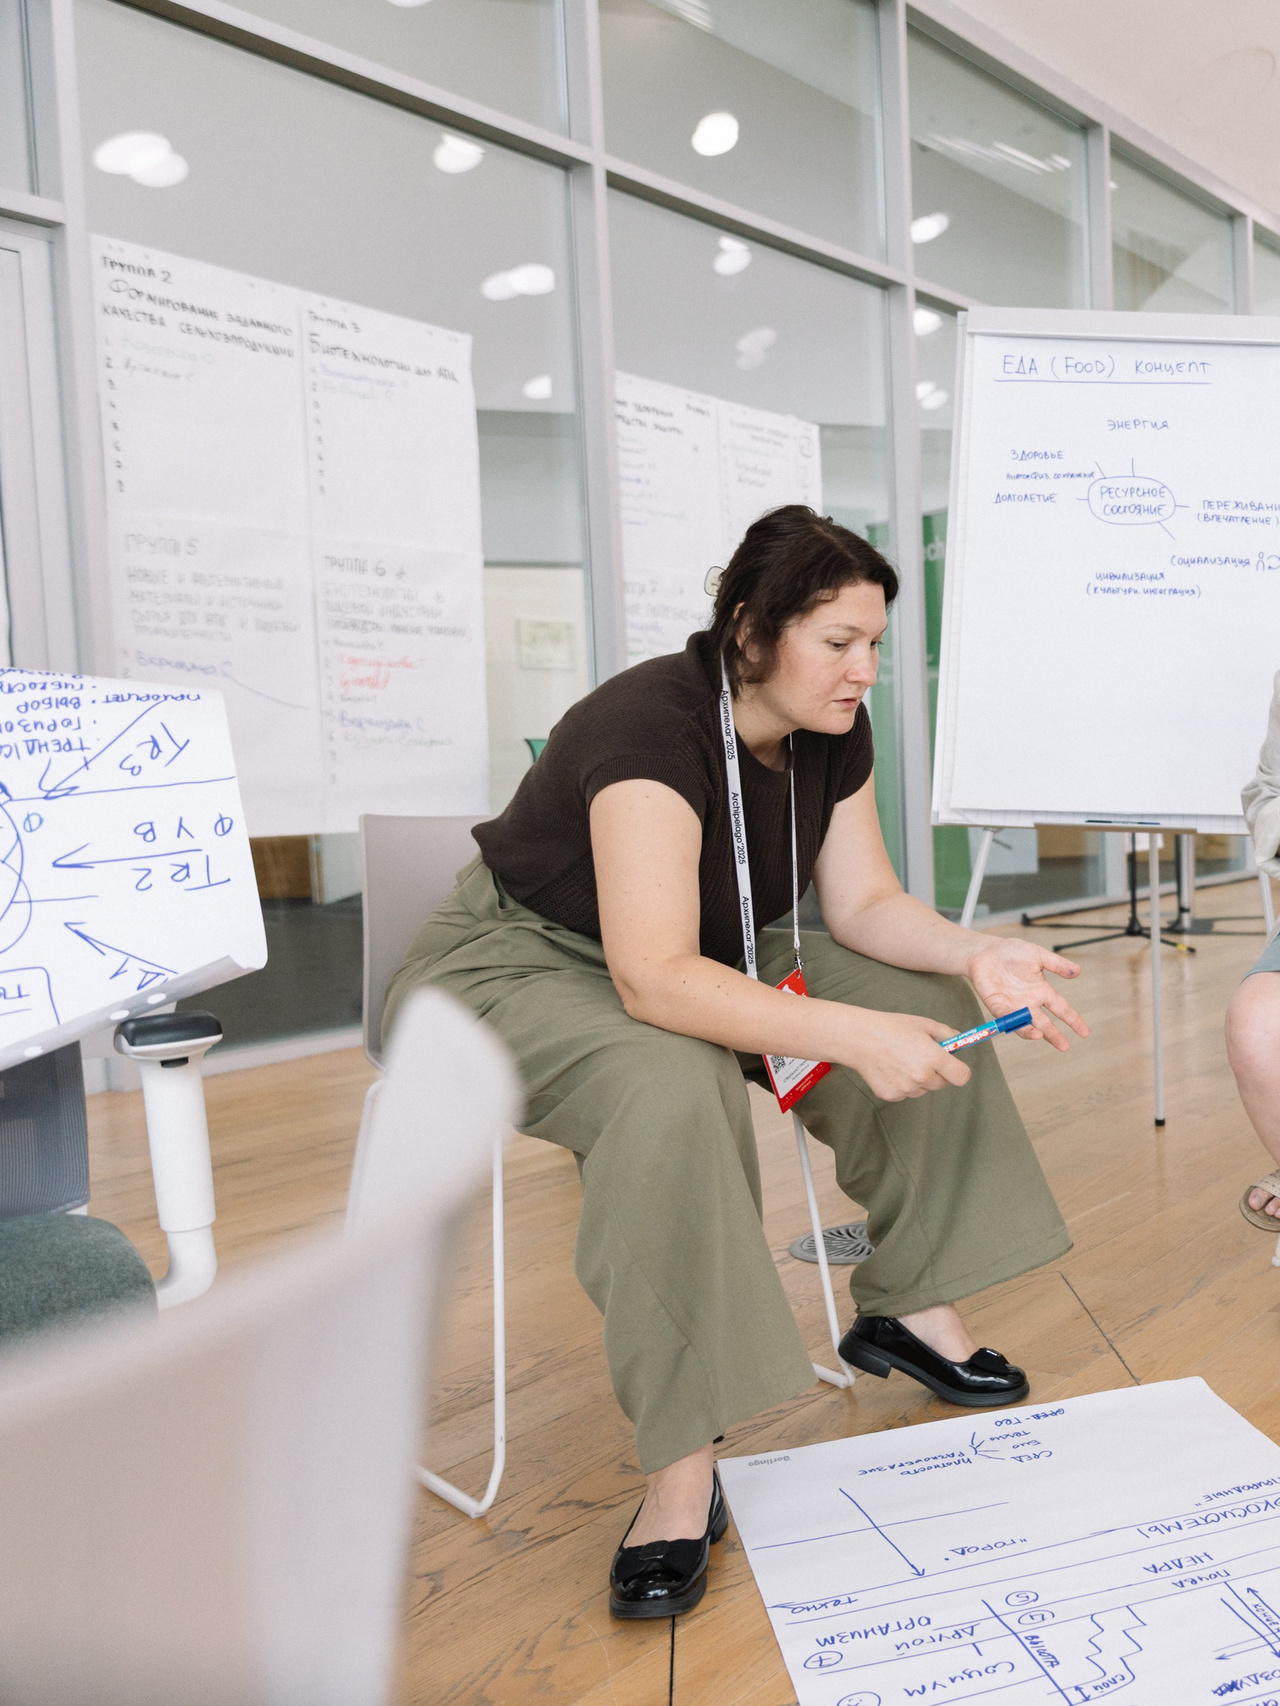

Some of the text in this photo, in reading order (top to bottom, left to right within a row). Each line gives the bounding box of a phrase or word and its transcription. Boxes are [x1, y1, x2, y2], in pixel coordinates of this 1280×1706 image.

[162, 271, 174, 285] 2
[1003, 355, 1038, 375] ЕДА
[1135, 361, 1211, 376] КОНЦЕПТ
[1107, 418, 1170, 431] ЭНЕРГИЯ
[1010, 449, 1064, 461] ЗДОРОВЬЕ
[994, 493, 1057, 504] ДОЛГОЛЕТИЕ
[1100, 485, 1167, 499] РЕСУРСНОЕ
[1103, 504, 1166, 516] СОСТОЯНИЕ
[1170, 554, 1251, 567] СОЦИАЛИЗАЦИЯ
[17, 697, 81, 714] ВЫБОР
[0, 717, 81, 733] ГОРИЗО
[957, 1031, 989, 1047] edding
[747, 1454, 792, 1468] Berlingo
[1141, 1550, 1214, 1578] НЕДРА
[1170, 1568, 1231, 1589] ПОЧВА
[815, 1616, 931, 1647] ОРГАНИЗМ
[895, 1623, 980, 1657] ДРУГОЙ
